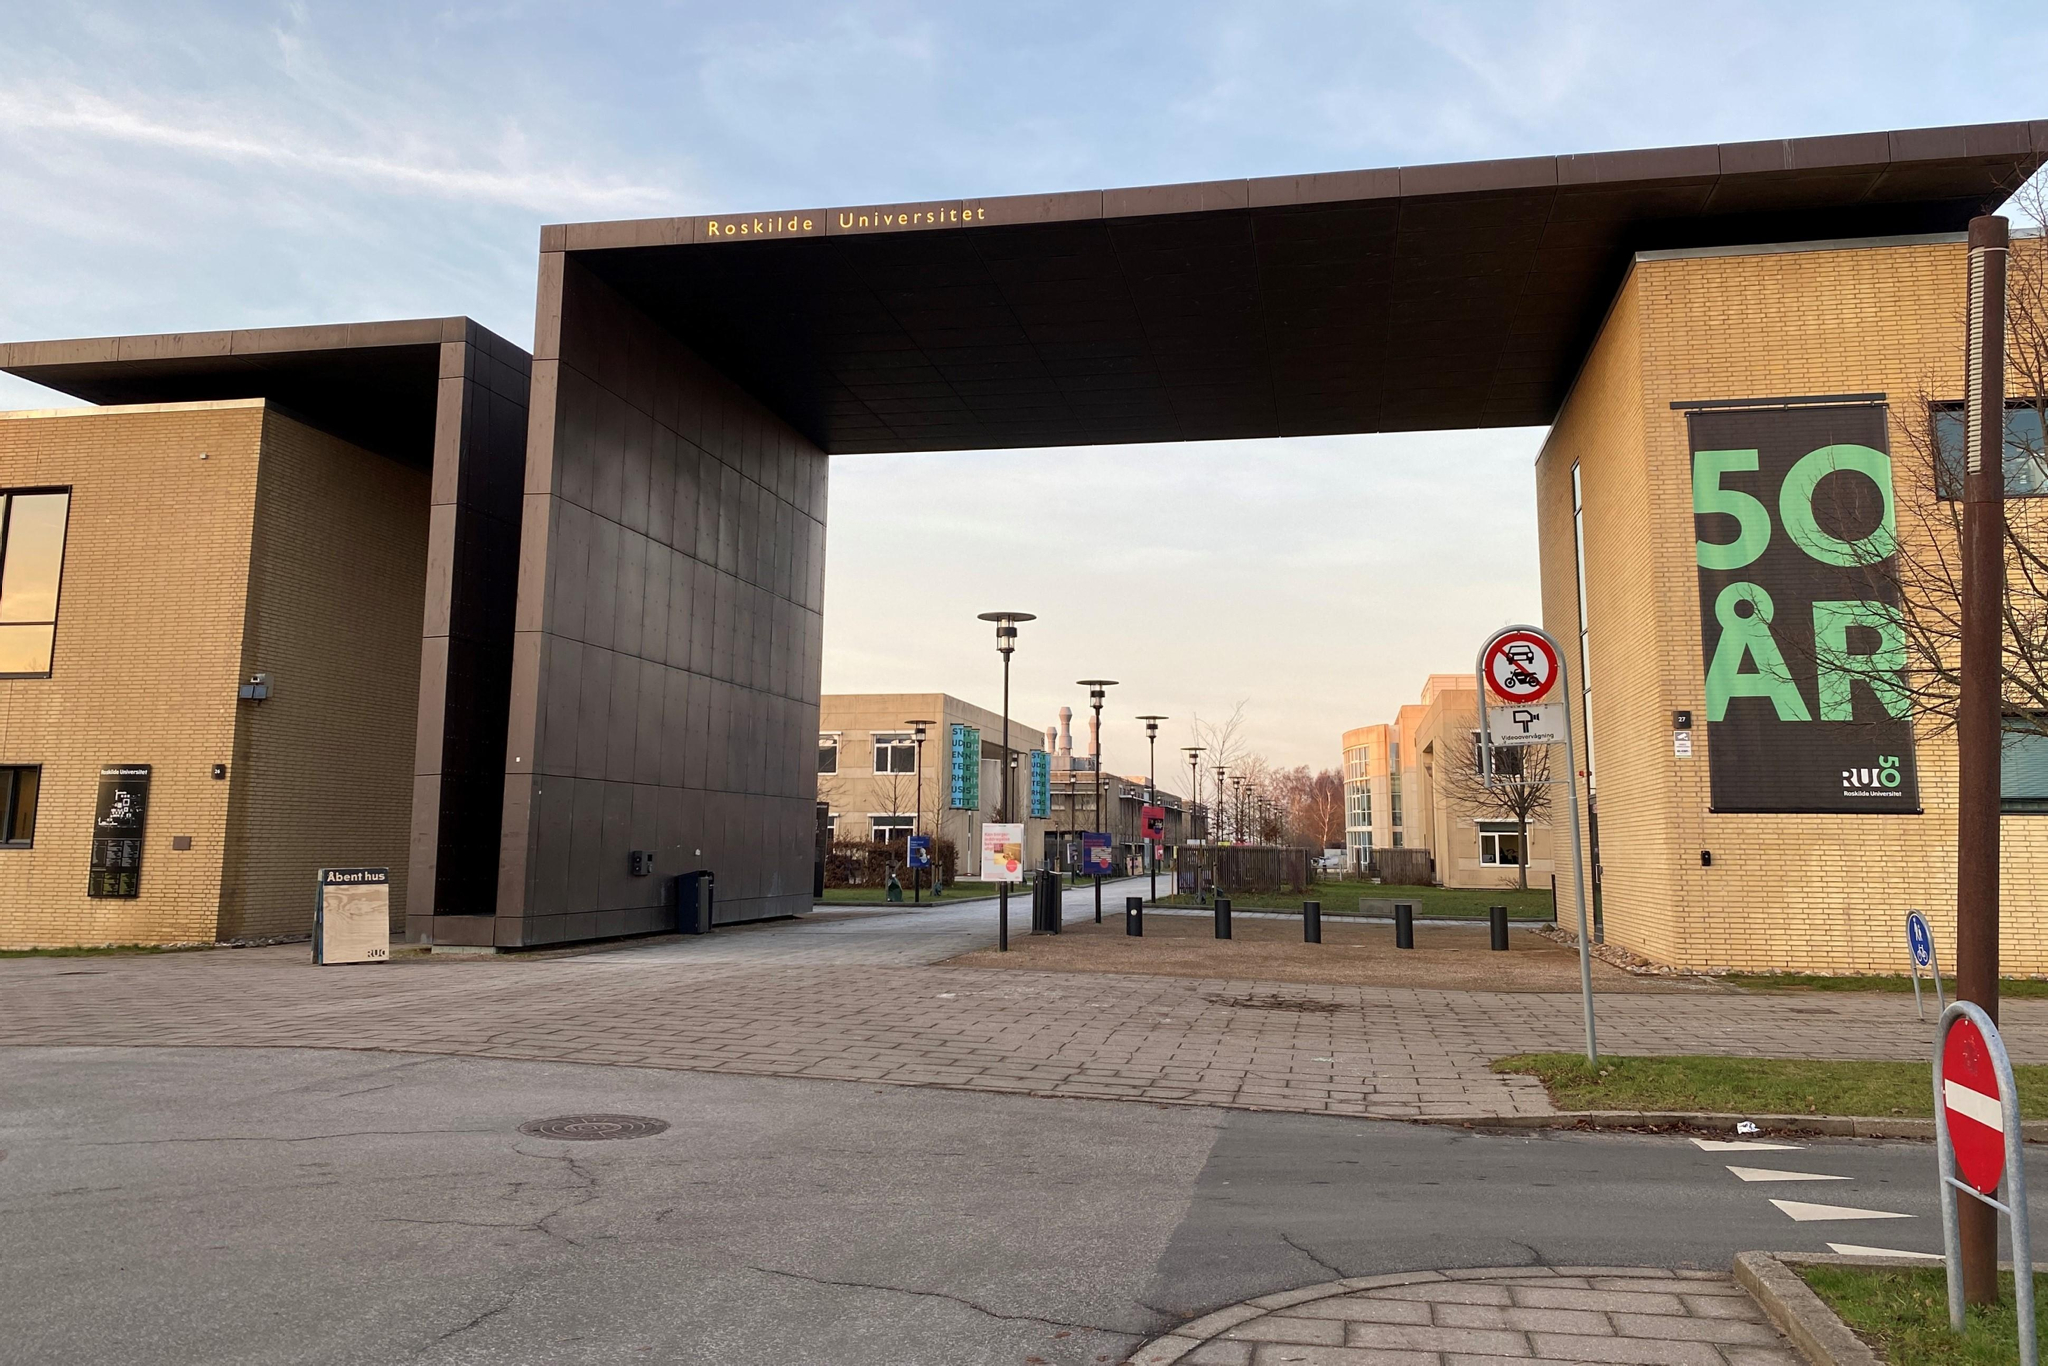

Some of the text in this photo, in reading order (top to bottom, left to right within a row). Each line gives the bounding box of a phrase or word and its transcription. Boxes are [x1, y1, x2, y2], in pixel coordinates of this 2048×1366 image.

[708, 206, 986, 237] Roskilde Universitet
[1692, 443, 1898, 571] 50
[1705, 581, 1913, 722] ÅR
[326, 871, 385, 882] Åbent hus
